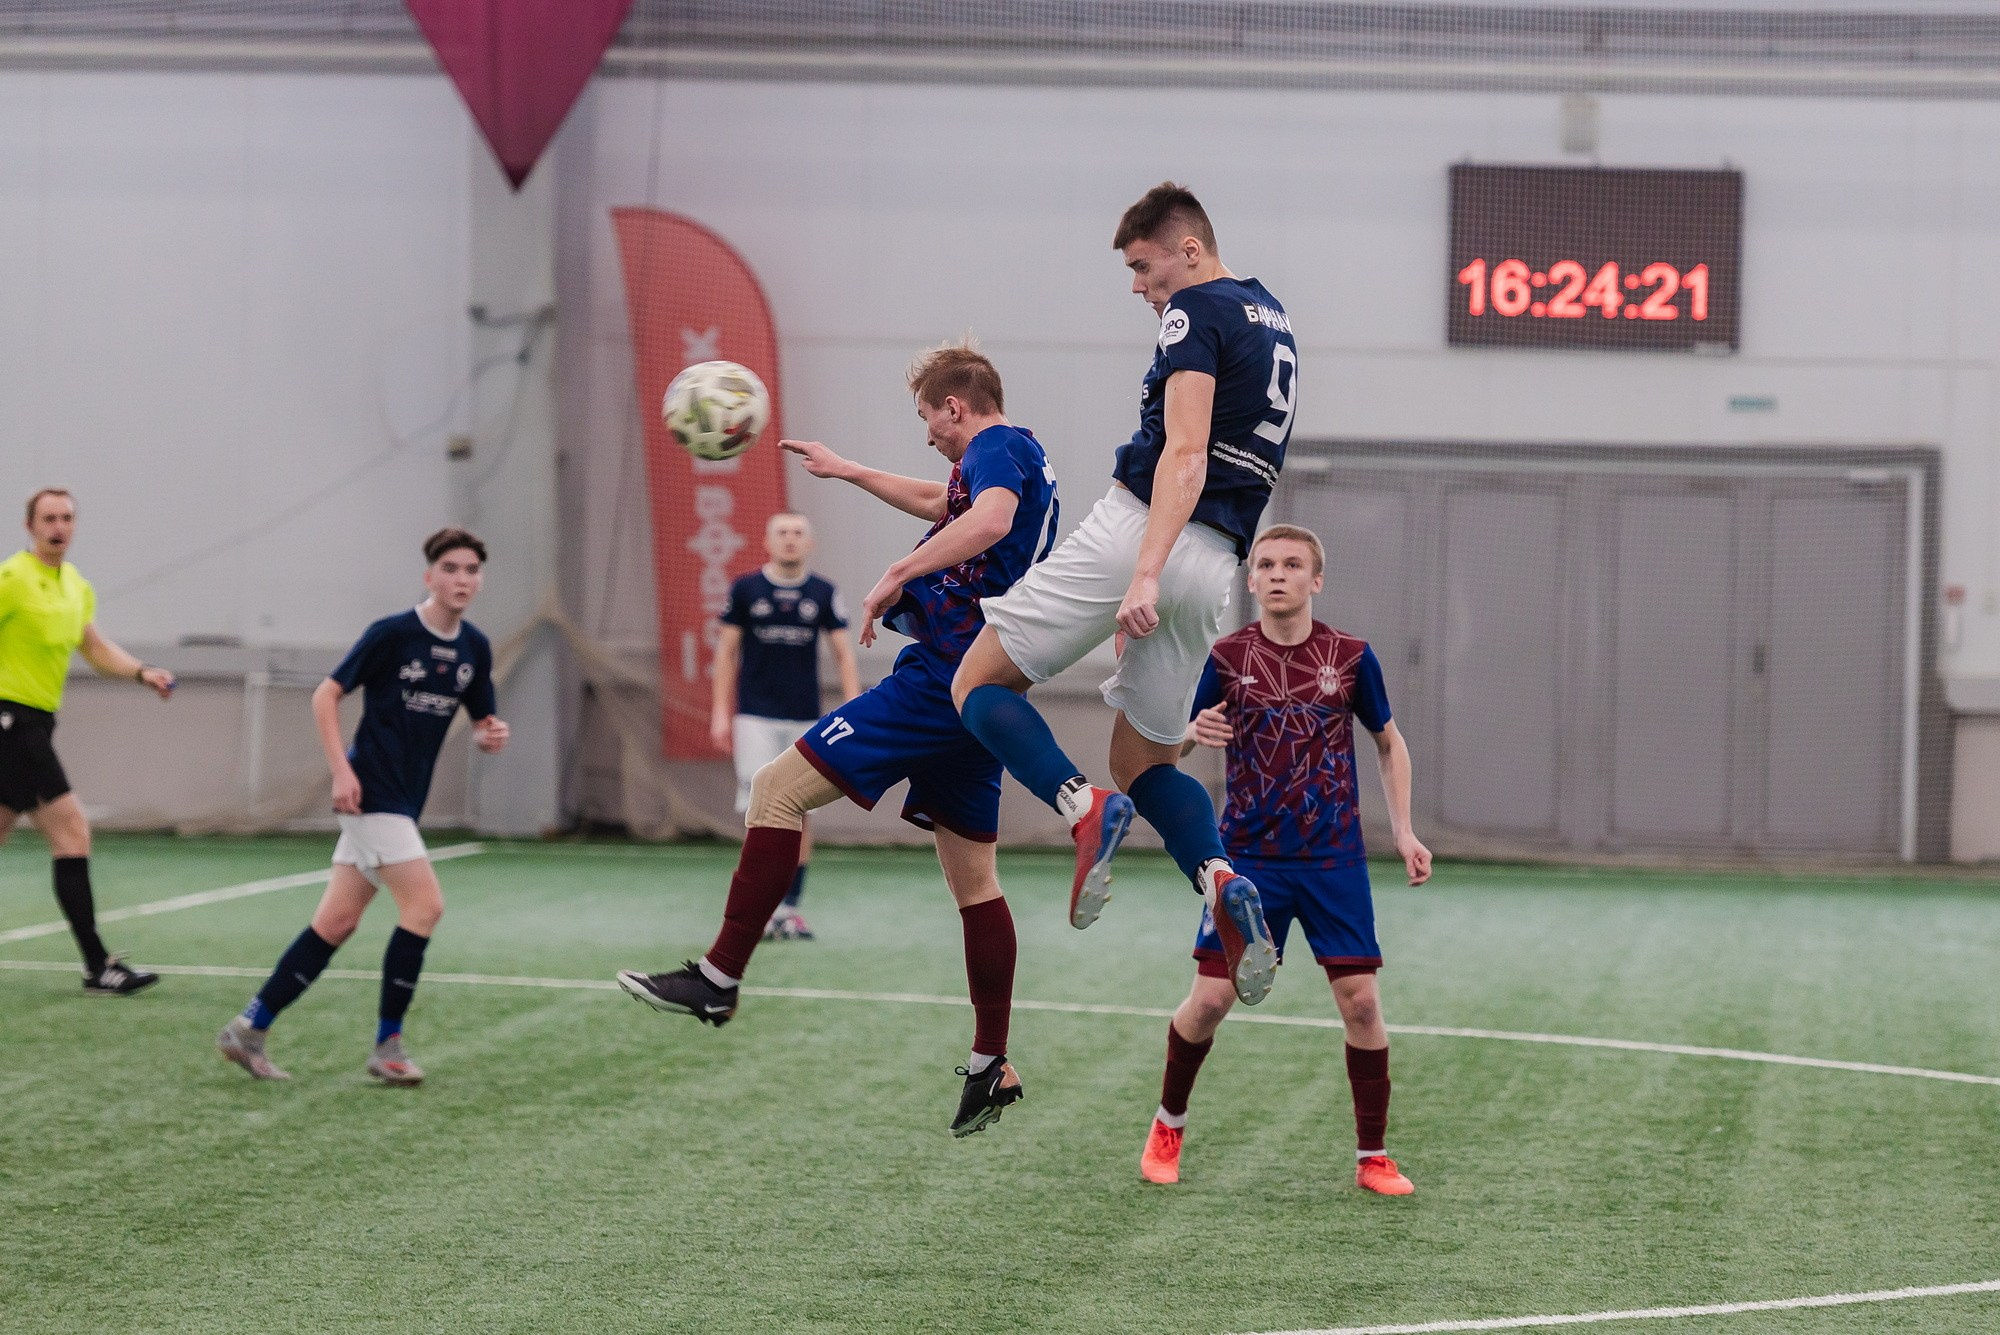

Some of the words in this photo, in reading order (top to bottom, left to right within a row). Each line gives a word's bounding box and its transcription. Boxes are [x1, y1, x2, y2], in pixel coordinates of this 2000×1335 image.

[1458, 258, 1709, 321] 16:24:21
[1253, 341, 1297, 445] 9
[820, 716, 855, 746] 17
